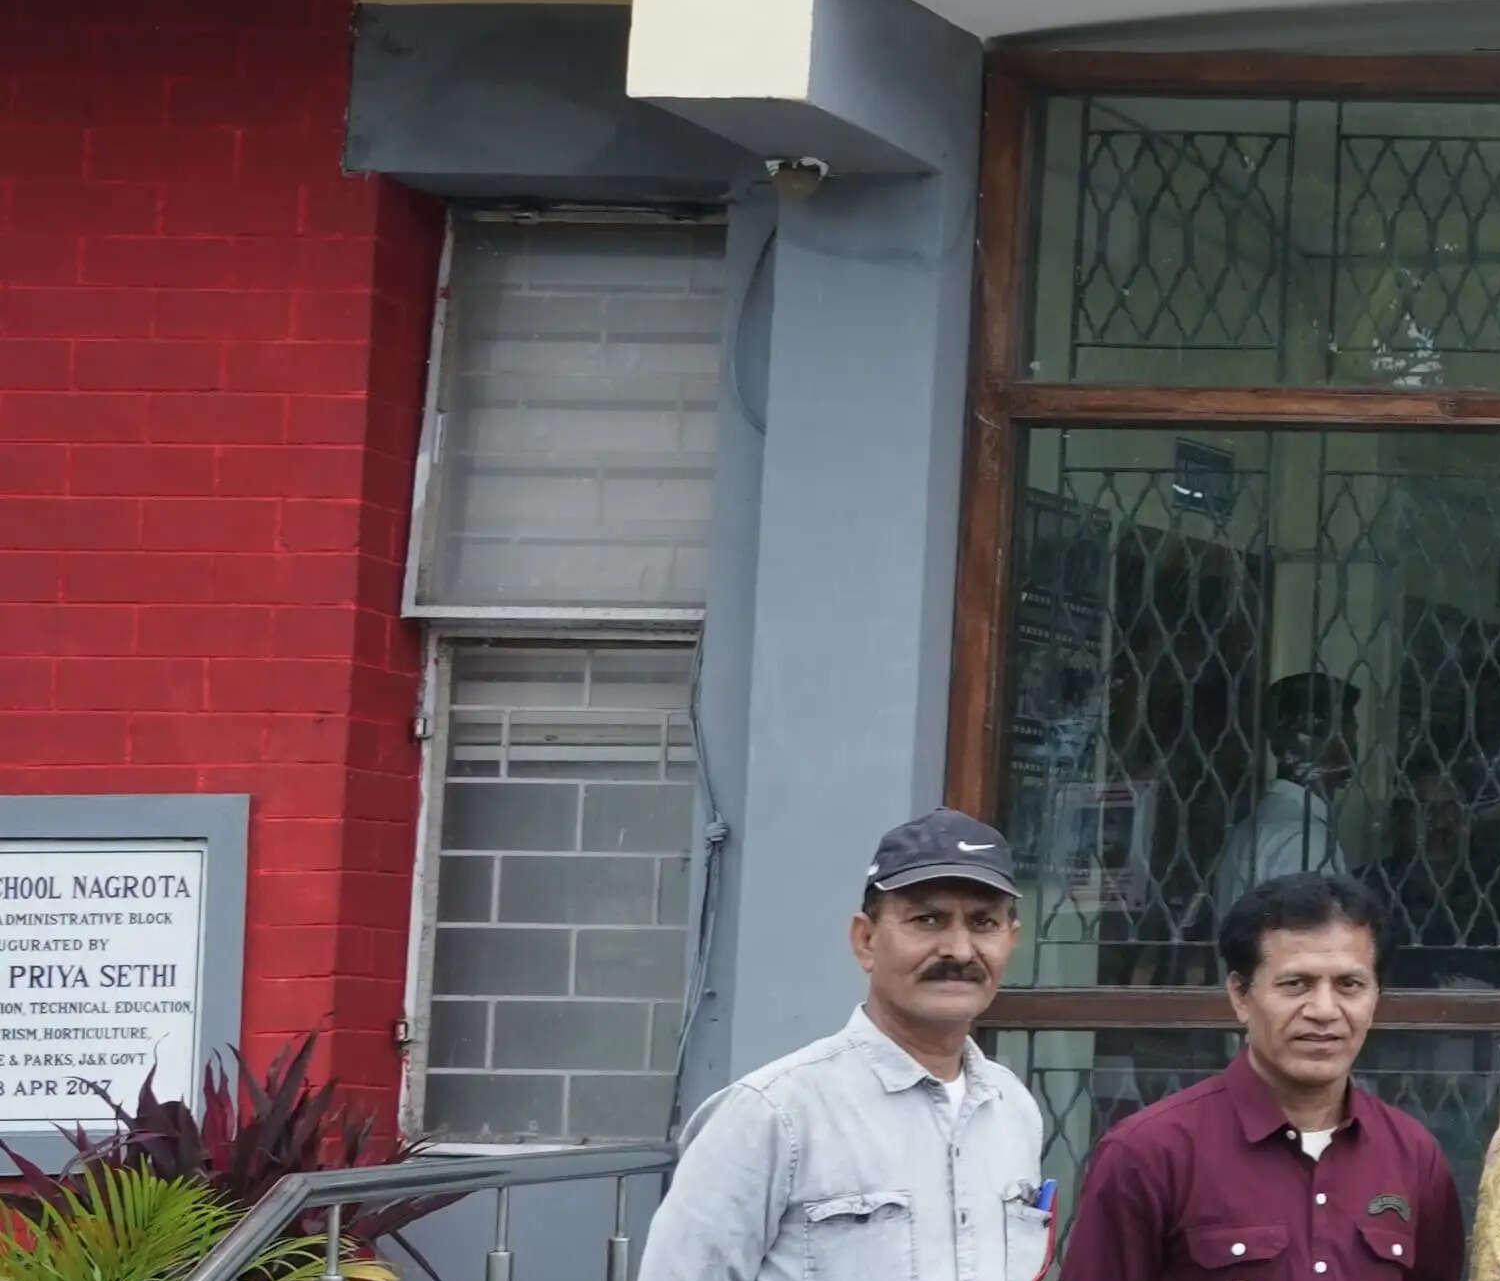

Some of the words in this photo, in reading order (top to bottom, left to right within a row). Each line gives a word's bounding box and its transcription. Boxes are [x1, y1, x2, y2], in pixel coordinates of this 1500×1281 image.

[0, 876, 61, 900] HOOL
[72, 874, 192, 899] NAGROTA
[128, 912, 173, 925] BLOCK
[88, 938, 110, 951] BY
[9, 964, 90, 989] PRIYA
[100, 963, 177, 988] SETHI
[30, 1001, 109, 1015] TECHNICAL
[9, 1053, 19, 1066] &
[78, 1053, 108, 1066] J&K
[13, 1079, 58, 1097] APR
